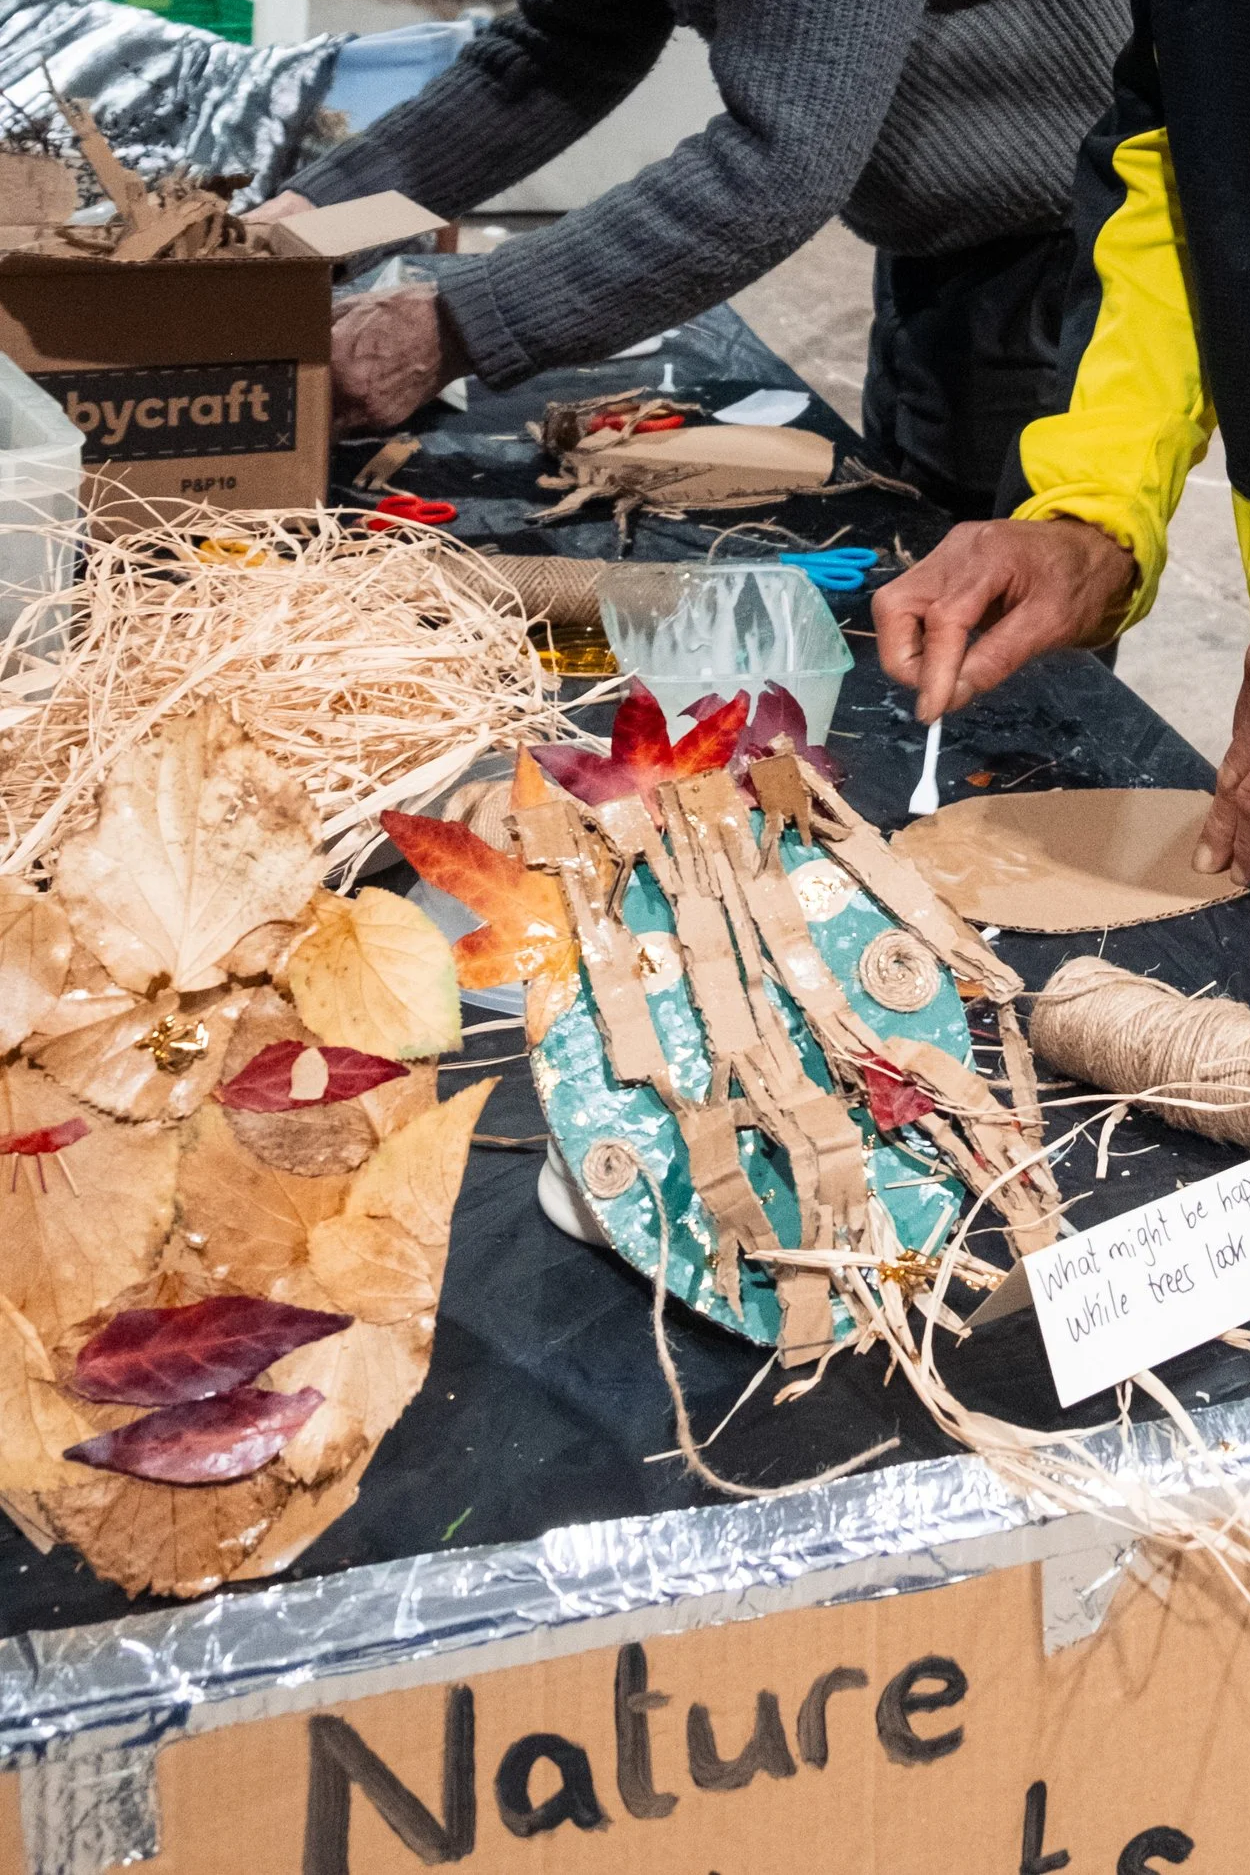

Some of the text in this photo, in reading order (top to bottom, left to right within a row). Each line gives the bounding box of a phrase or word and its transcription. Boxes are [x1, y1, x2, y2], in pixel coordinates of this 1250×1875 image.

[1036, 1238, 1101, 1301] What
[1109, 1208, 1171, 1267] might
[1180, 1200, 1208, 1229] be
[1148, 1263, 1195, 1304] trees
[1205, 1232, 1247, 1279] look
[301, 1641, 970, 1875] Nature
